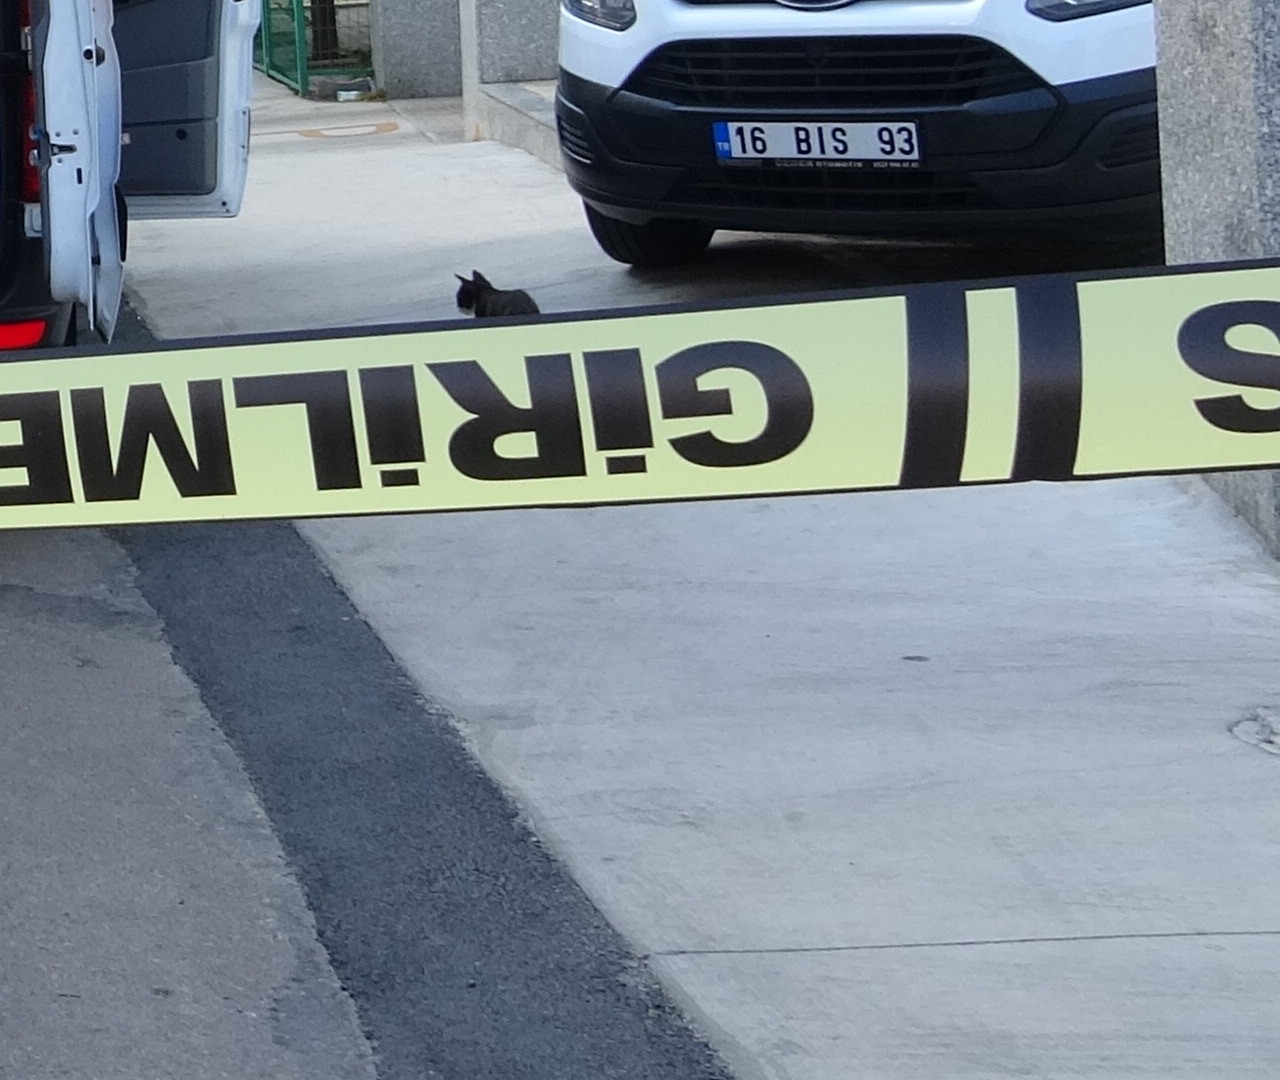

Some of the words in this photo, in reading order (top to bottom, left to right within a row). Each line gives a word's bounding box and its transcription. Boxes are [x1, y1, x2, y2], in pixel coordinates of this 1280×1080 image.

[717, 141, 730, 151] TR
[735, 126, 768, 155] 16
[794, 126, 849, 155] BIS
[877, 126, 916, 156] 93
